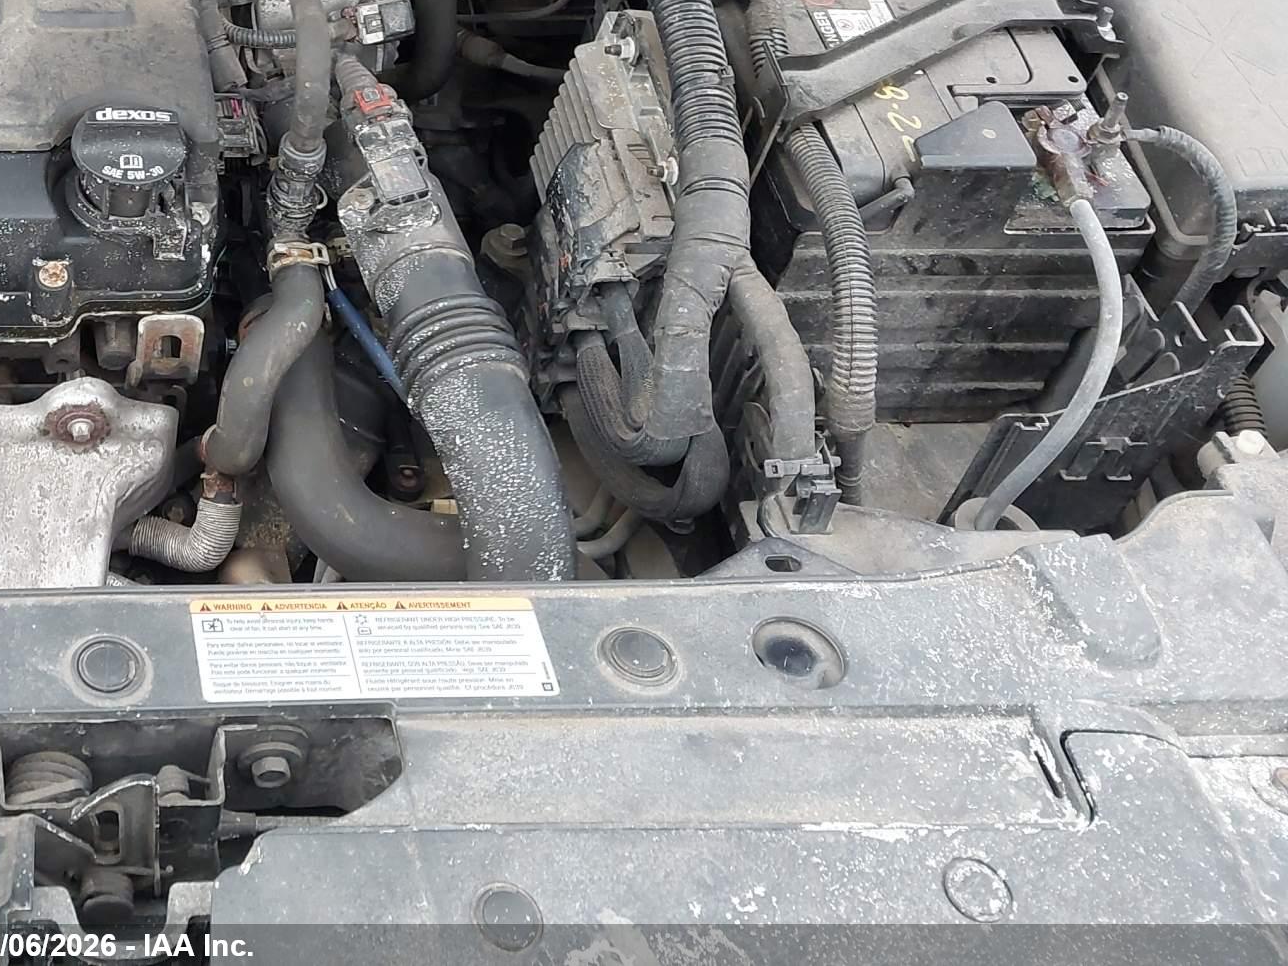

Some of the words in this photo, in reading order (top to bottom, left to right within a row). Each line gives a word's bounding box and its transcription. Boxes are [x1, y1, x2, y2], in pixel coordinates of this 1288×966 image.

[95, 107, 173, 122] dexos
[102, 165, 124, 179] SAE
[127, 165, 164, 180] 5W-30
[213, 603, 252, 611] WARNING
[274, 603, 327, 611] ADVERTENCIA
[408, 601, 472, 610] AVERTISSEMENT
